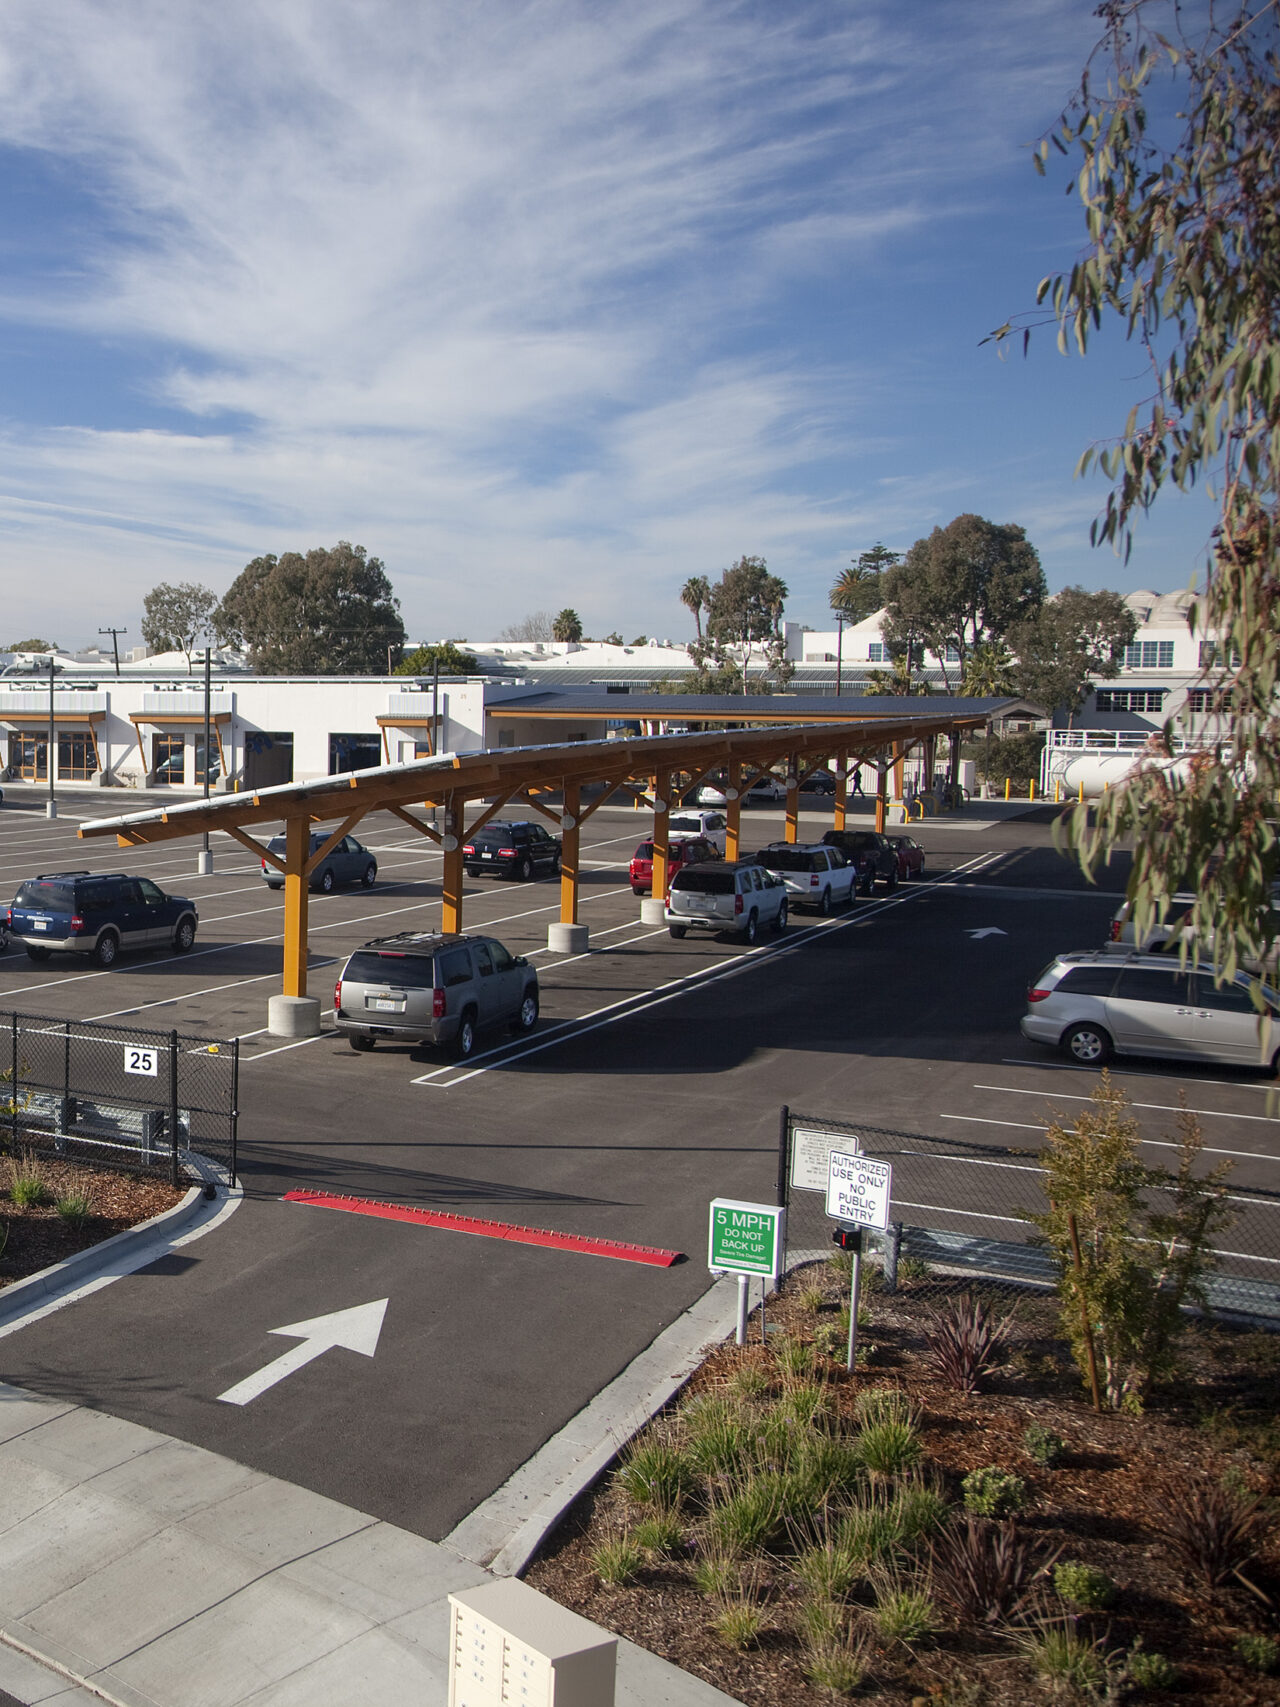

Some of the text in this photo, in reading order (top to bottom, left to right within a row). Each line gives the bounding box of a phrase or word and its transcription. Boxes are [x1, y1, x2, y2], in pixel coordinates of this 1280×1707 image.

[130, 1051, 152, 1071] 25
[832, 1155, 888, 1177] AUTHORIZED
[832, 1167, 854, 1181] USE
[858, 1173, 885, 1188] ONLY
[850, 1183, 866, 1196] NO
[838, 1192, 876, 1211] PUBLIC
[716, 1210, 771, 1232] 5 MPH
[839, 1204, 874, 1222] ENTRY
[724, 1227, 764, 1241] DO NOT
[721, 1238, 766, 1253] BACK UP
